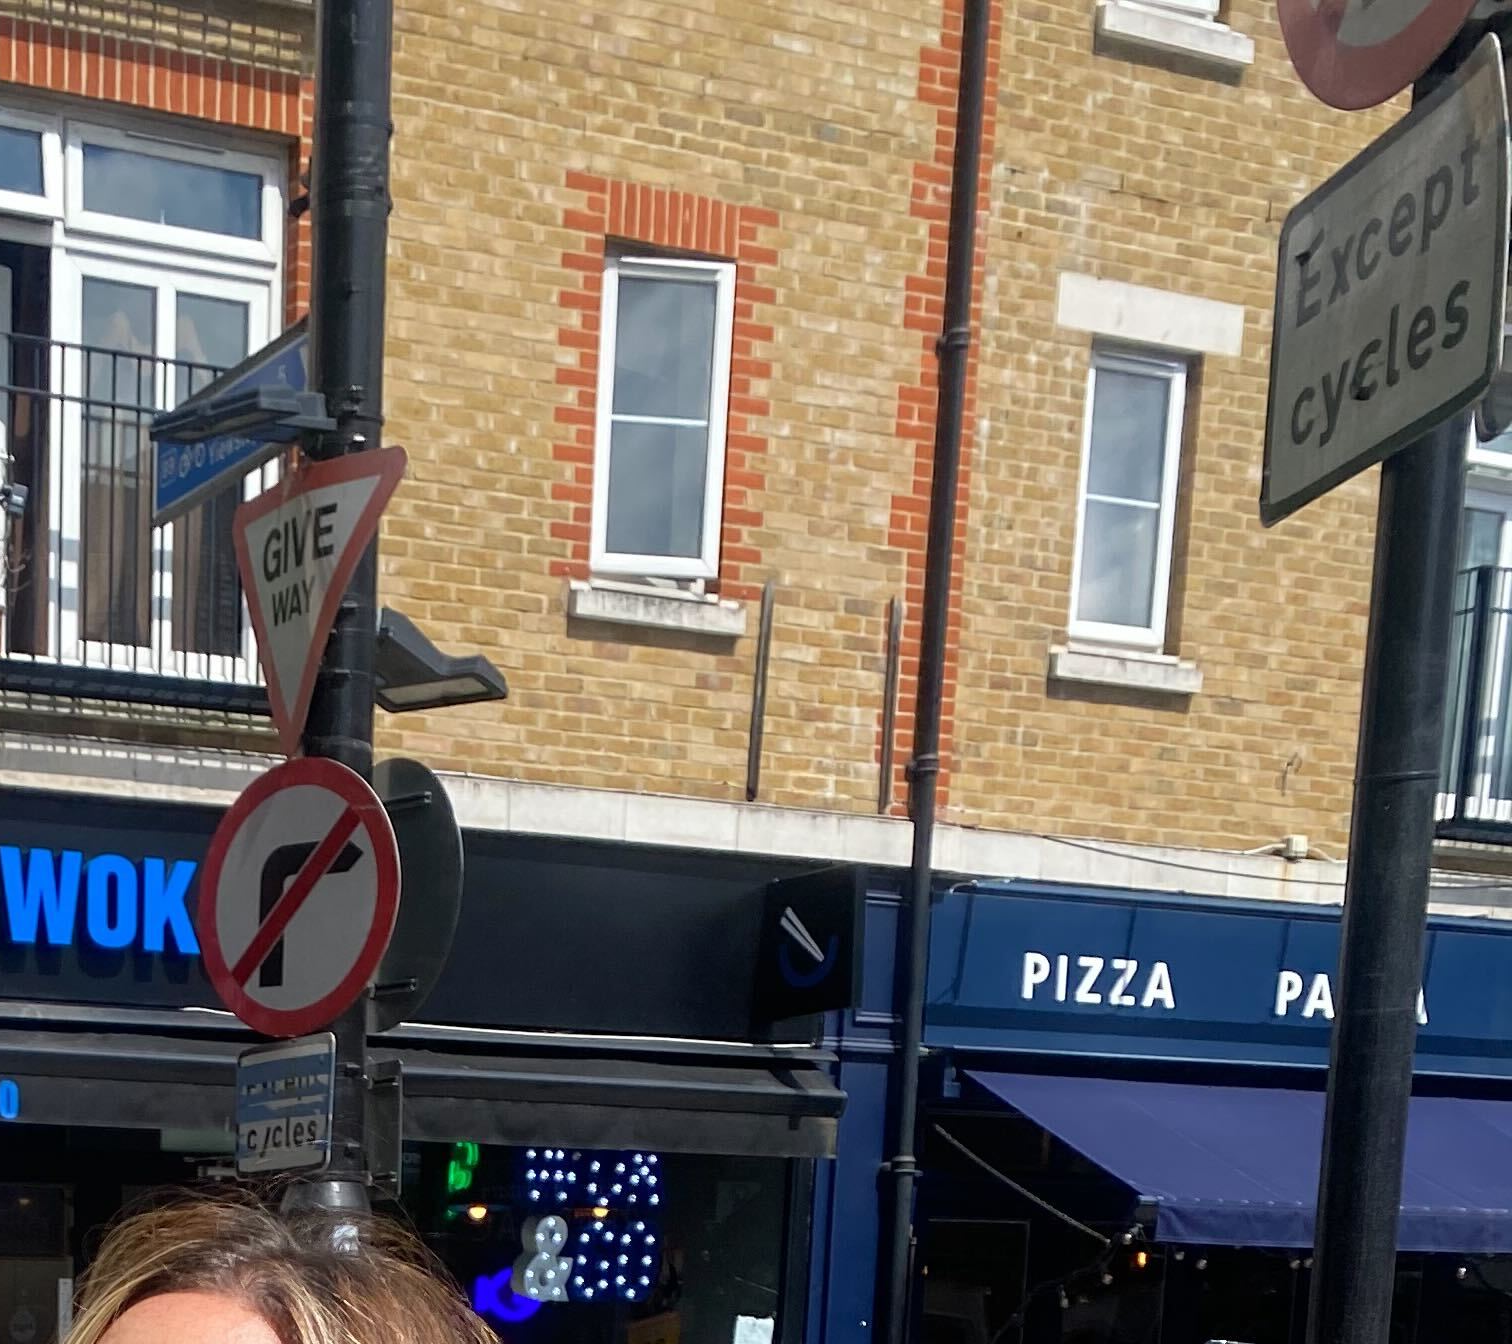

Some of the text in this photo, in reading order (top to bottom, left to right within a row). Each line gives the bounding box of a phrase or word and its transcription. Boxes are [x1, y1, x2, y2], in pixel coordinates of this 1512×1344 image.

[1294, 133, 1482, 329] Except
[1290, 278, 1472, 448] cycles
[262, 502, 338, 583] GIVE
[271, 575, 316, 627] WAY
[1020, 951, 1176, 1010] PIZZA
